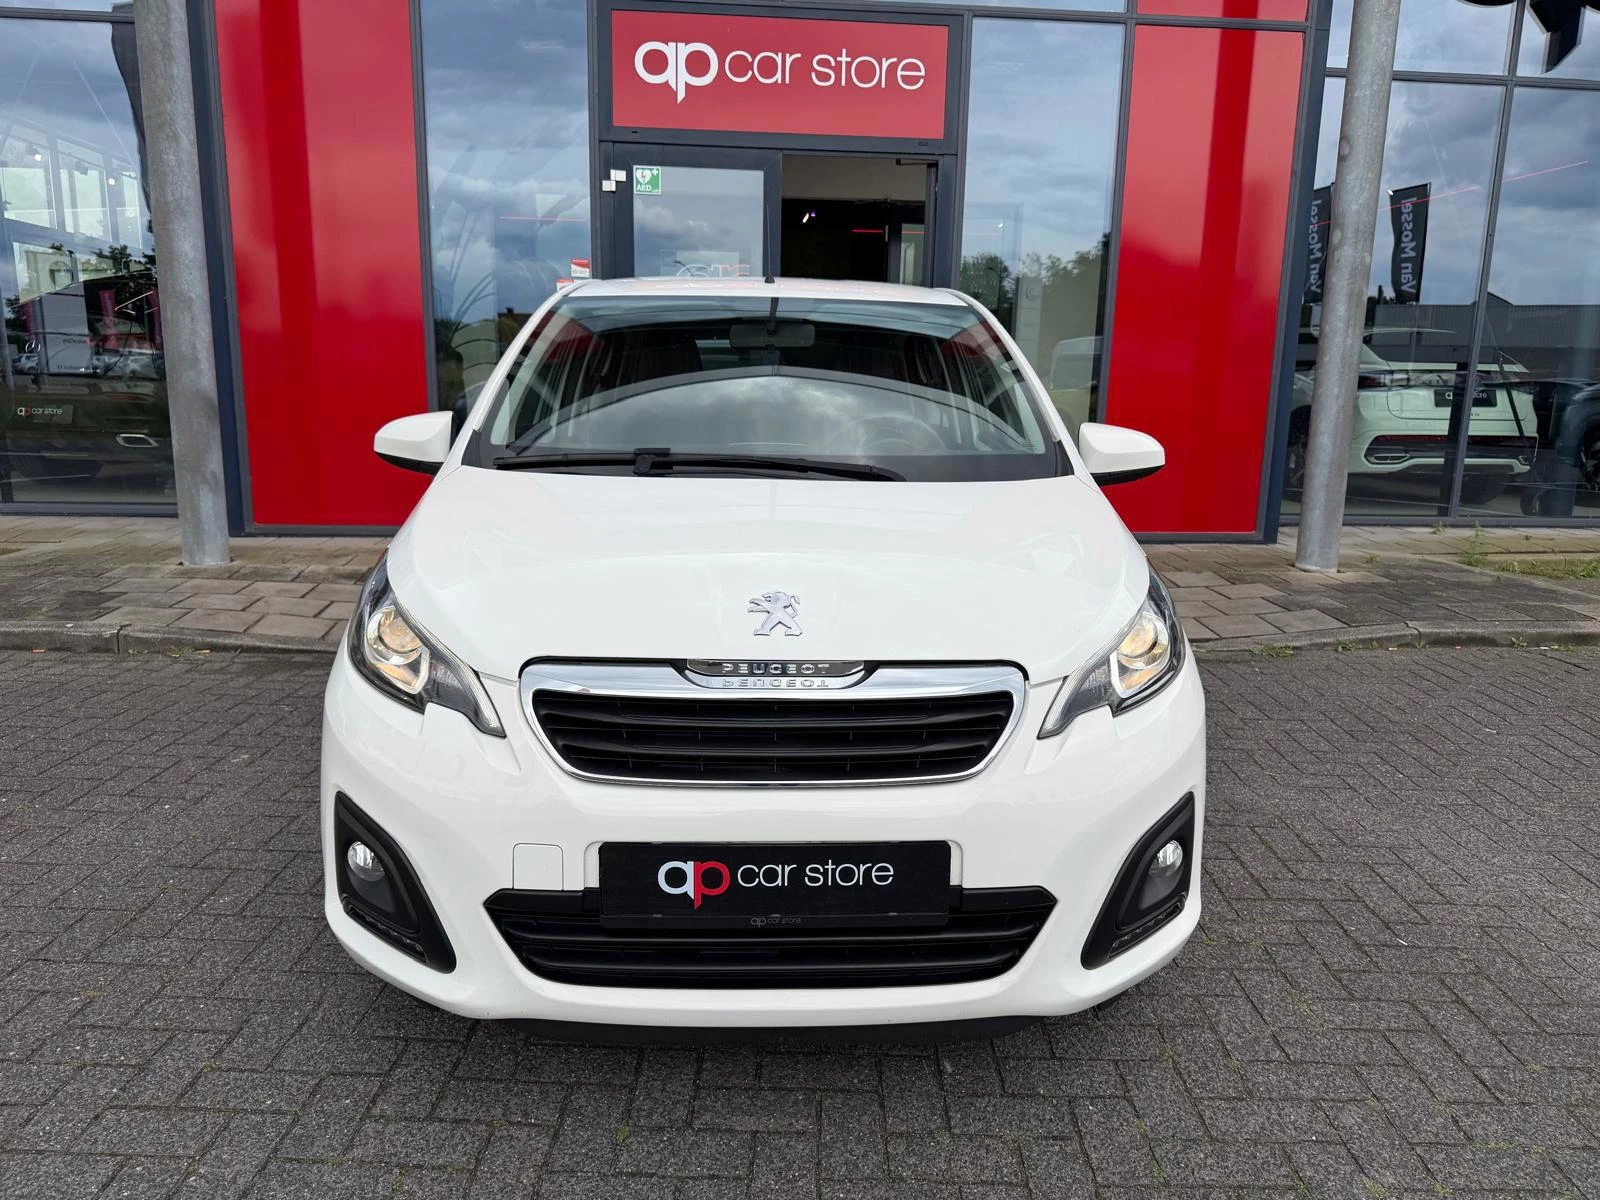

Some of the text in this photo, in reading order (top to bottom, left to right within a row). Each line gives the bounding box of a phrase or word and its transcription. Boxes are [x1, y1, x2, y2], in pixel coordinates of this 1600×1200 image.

[634, 41, 926, 104] ap car store
[636, 184, 652, 192] AED
[722, 663, 830, 674] PEUGEOT
[657, 859, 894, 910] ap car store
